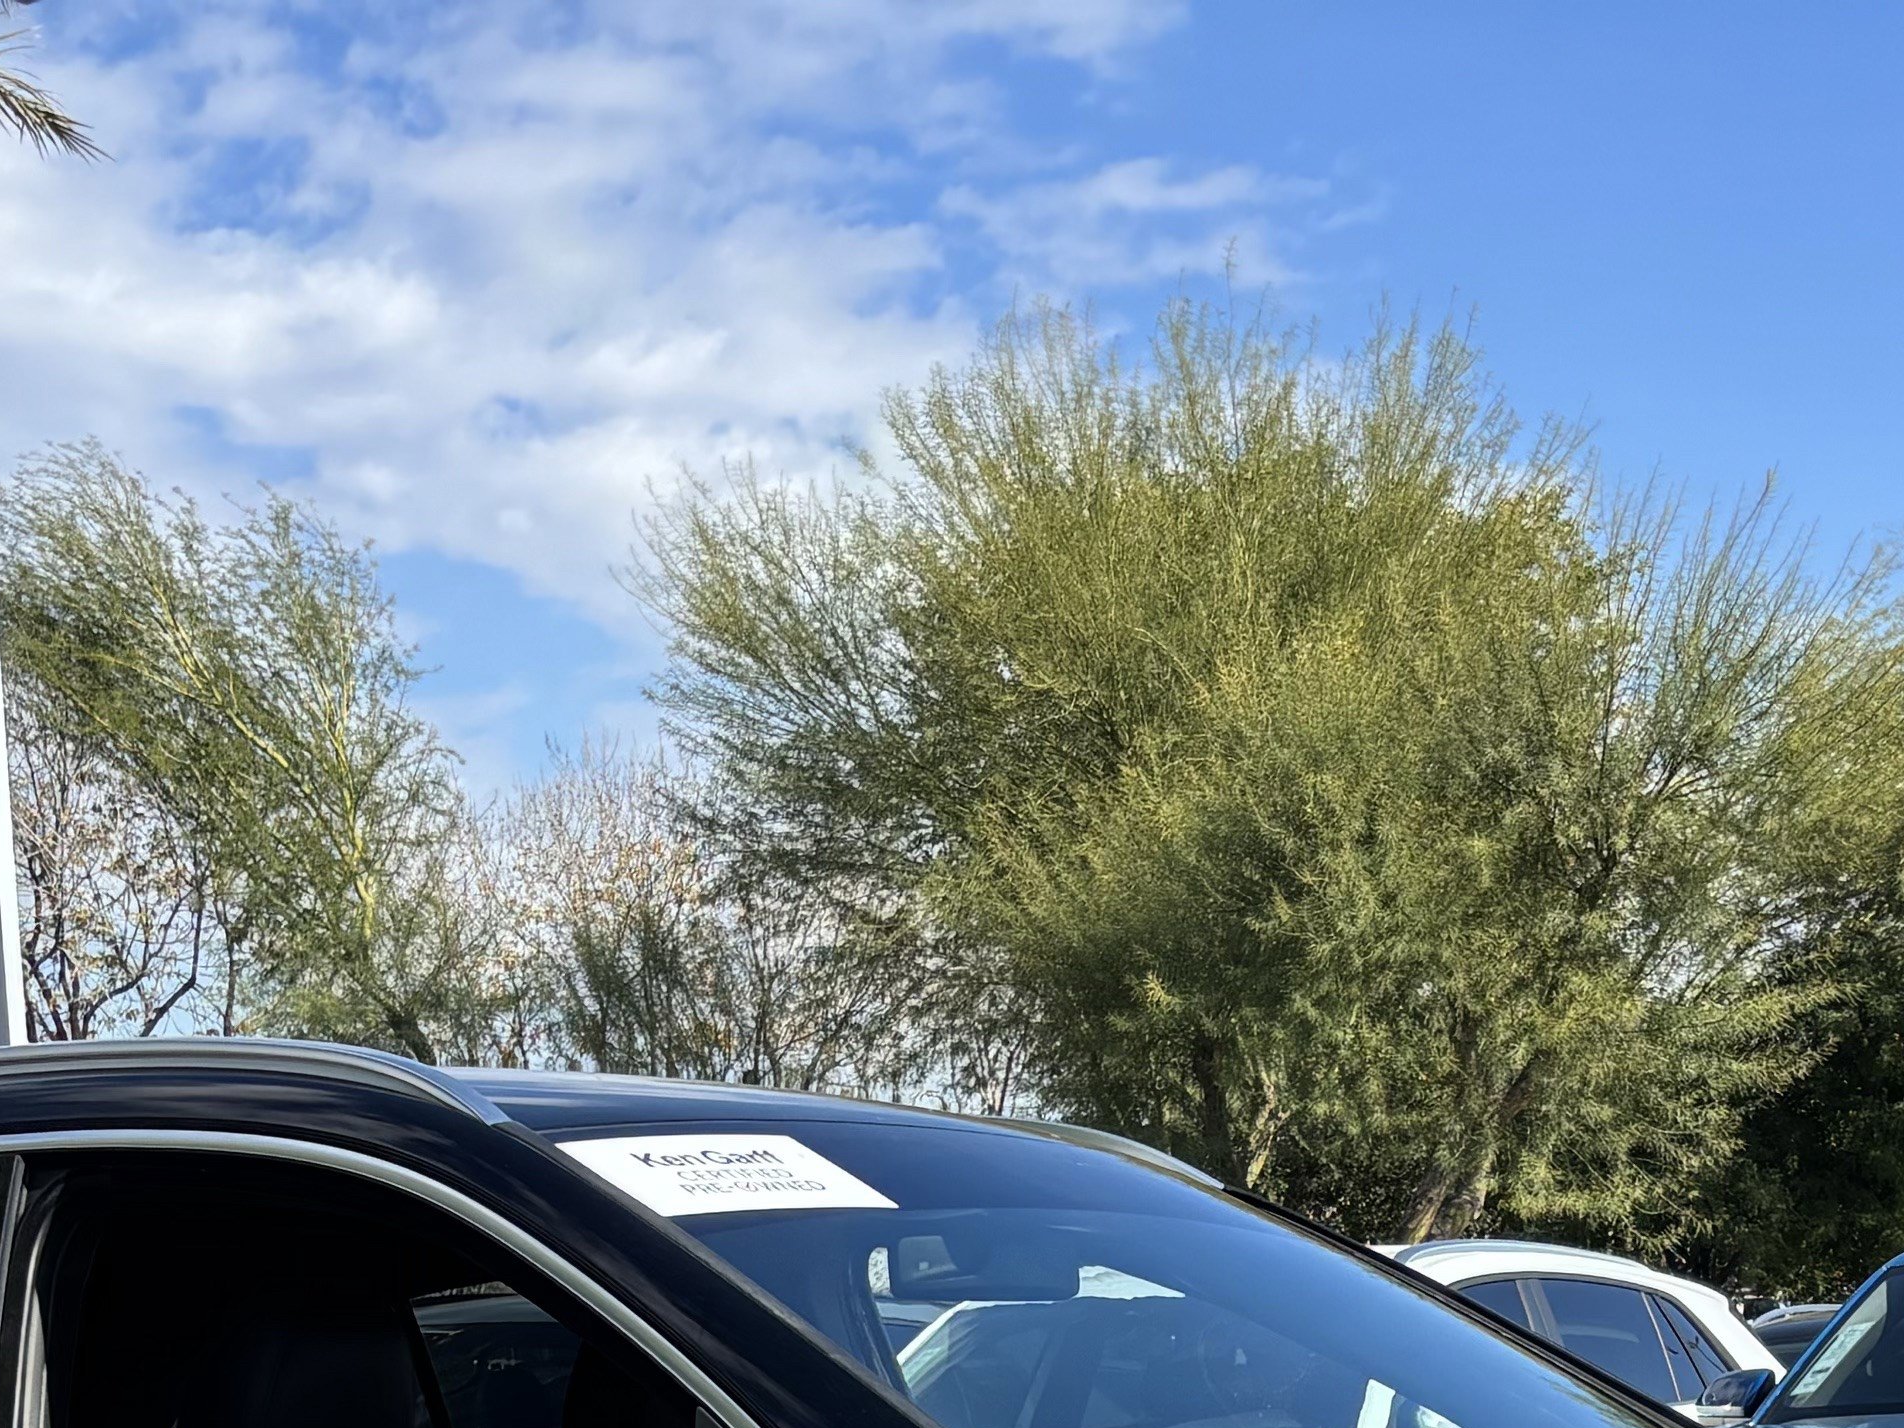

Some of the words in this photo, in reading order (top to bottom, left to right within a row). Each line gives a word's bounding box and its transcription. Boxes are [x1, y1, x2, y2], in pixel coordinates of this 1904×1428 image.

[629, 1151, 702, 1168] Ken
[677, 1168, 794, 1182] CERTIFIED
[679, 1179, 827, 1196] PRE-OWNED
